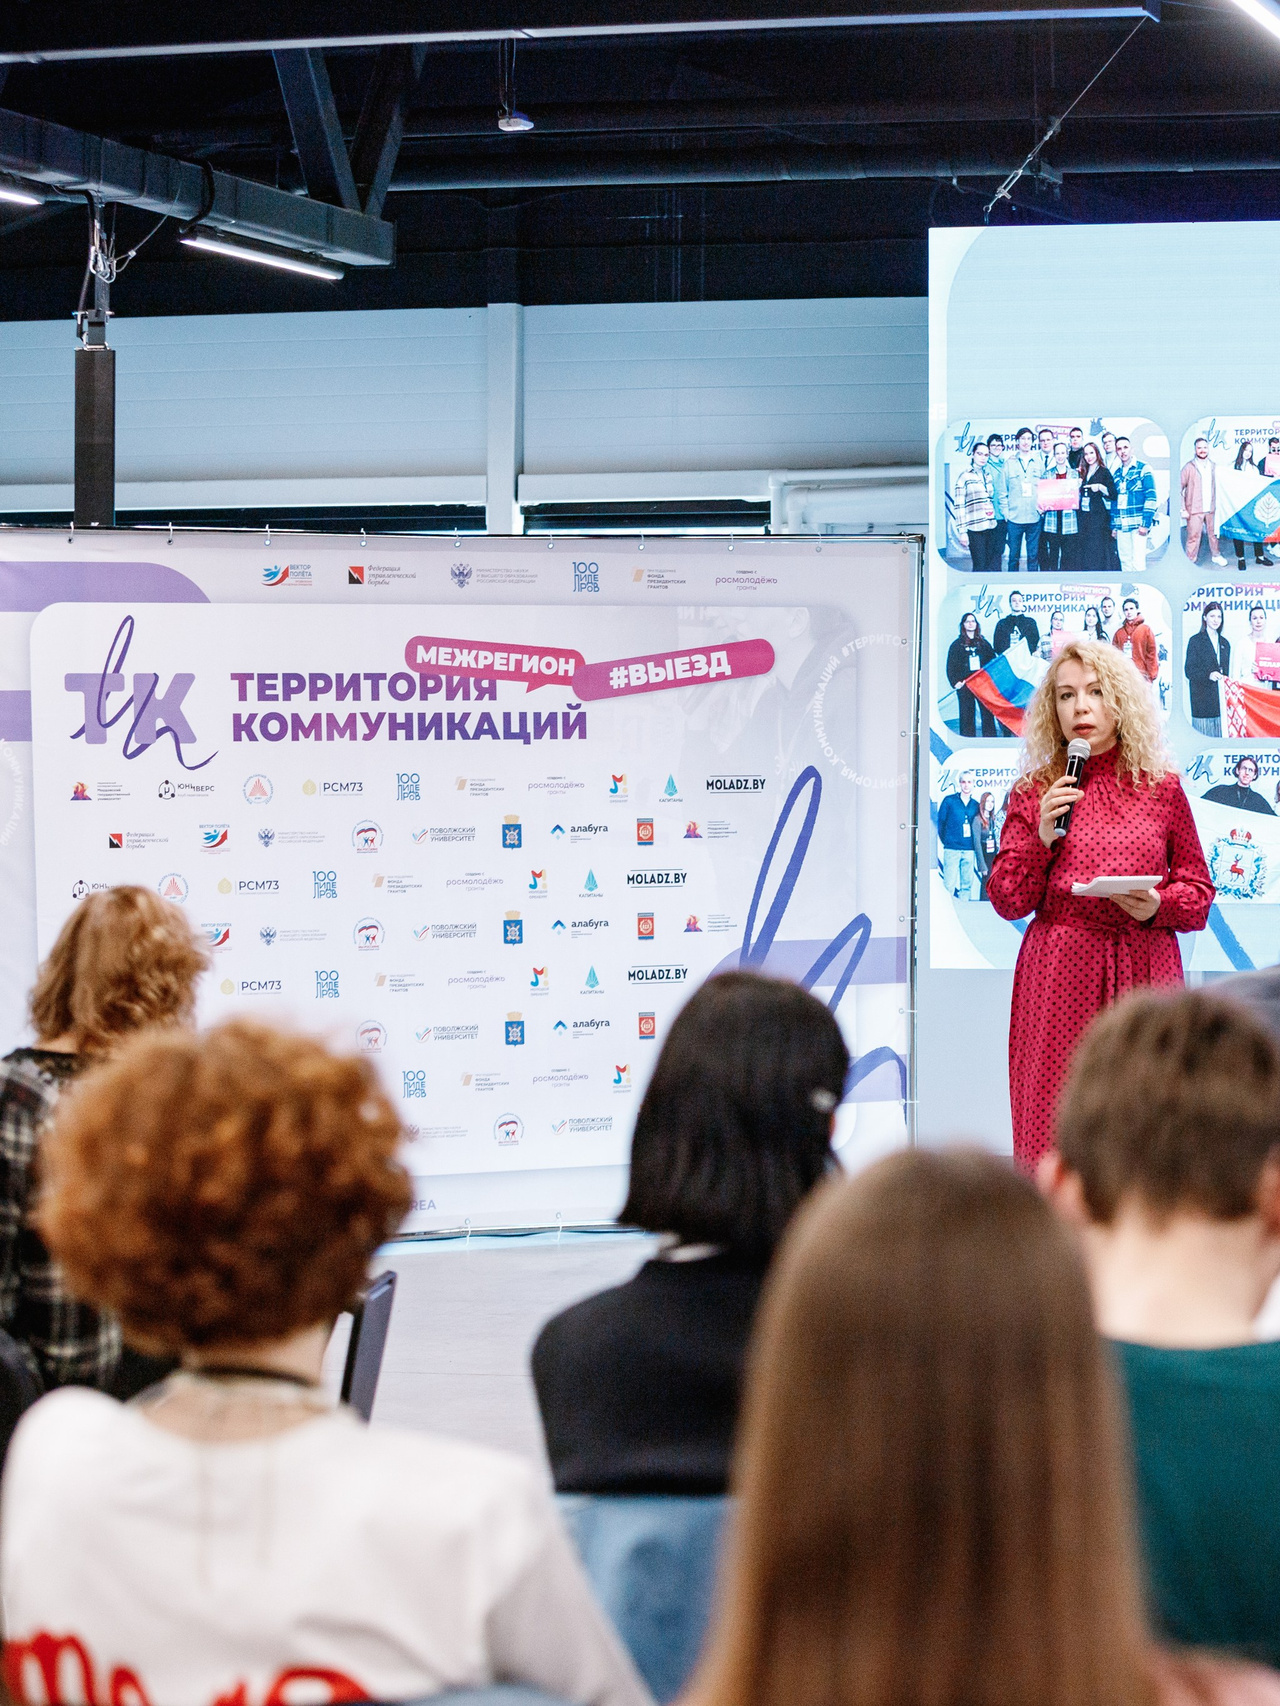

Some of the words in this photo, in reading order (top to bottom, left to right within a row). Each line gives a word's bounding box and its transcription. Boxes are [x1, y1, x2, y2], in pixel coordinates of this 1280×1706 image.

[572, 561, 599, 574] 100
[367, 572, 417, 580] управленческой
[715, 576, 778, 587] росмолодёжь
[367, 578, 390, 586] борьбы
[1021, 593, 1086, 602] ЕРРИТОРИЯ
[416, 645, 576, 677] МЕЖРЕГИОН
[609, 650, 732, 690] #ВЫЕЗД
[230, 672, 497, 702] ТЕРРИТОРИЯ
[232, 703, 587, 745] КОММУНИКАЦИЙ
[396, 773, 420, 784] 100
[323, 782, 363, 792] РСМ73
[528, 781, 585, 791] росмолодёжь
[706, 778, 766, 791] MOLADZ.BY
[430, 825, 476, 834] ПОВОЛЖСКИЙ
[570, 823, 608, 836] алабуга
[313, 871, 337, 881] 100
[627, 872, 687, 885] MOLADZ.BY
[238, 880, 280, 891] РСМ73
[446, 877, 504, 888] росмолодёжь
[431, 922, 477, 931] ПОВОЛЖСКИЙ
[571, 918, 609, 929] алабуга
[432, 931, 476, 939] УНИВЕРСИТЕТ
[315, 970, 339, 982] 100
[628, 968, 688, 981] MOLADZ.BY
[241, 980, 282, 991] РСМ73
[448, 975, 505, 987] росмолодёжь
[433, 1023, 479, 1033] ПОВОЛЖСКИЙ
[572, 1018, 610, 1029] алабуга
[433, 1033, 478, 1041] УНИВЕРСИТЕТ
[402, 1070, 426, 1082] 100
[532, 1073, 589, 1084] росмолодёжь
[568, 1115, 613, 1124] ПОВОЛЖСКИЙ
[569, 1124, 612, 1133] УНИВЕРСИТЕТ
